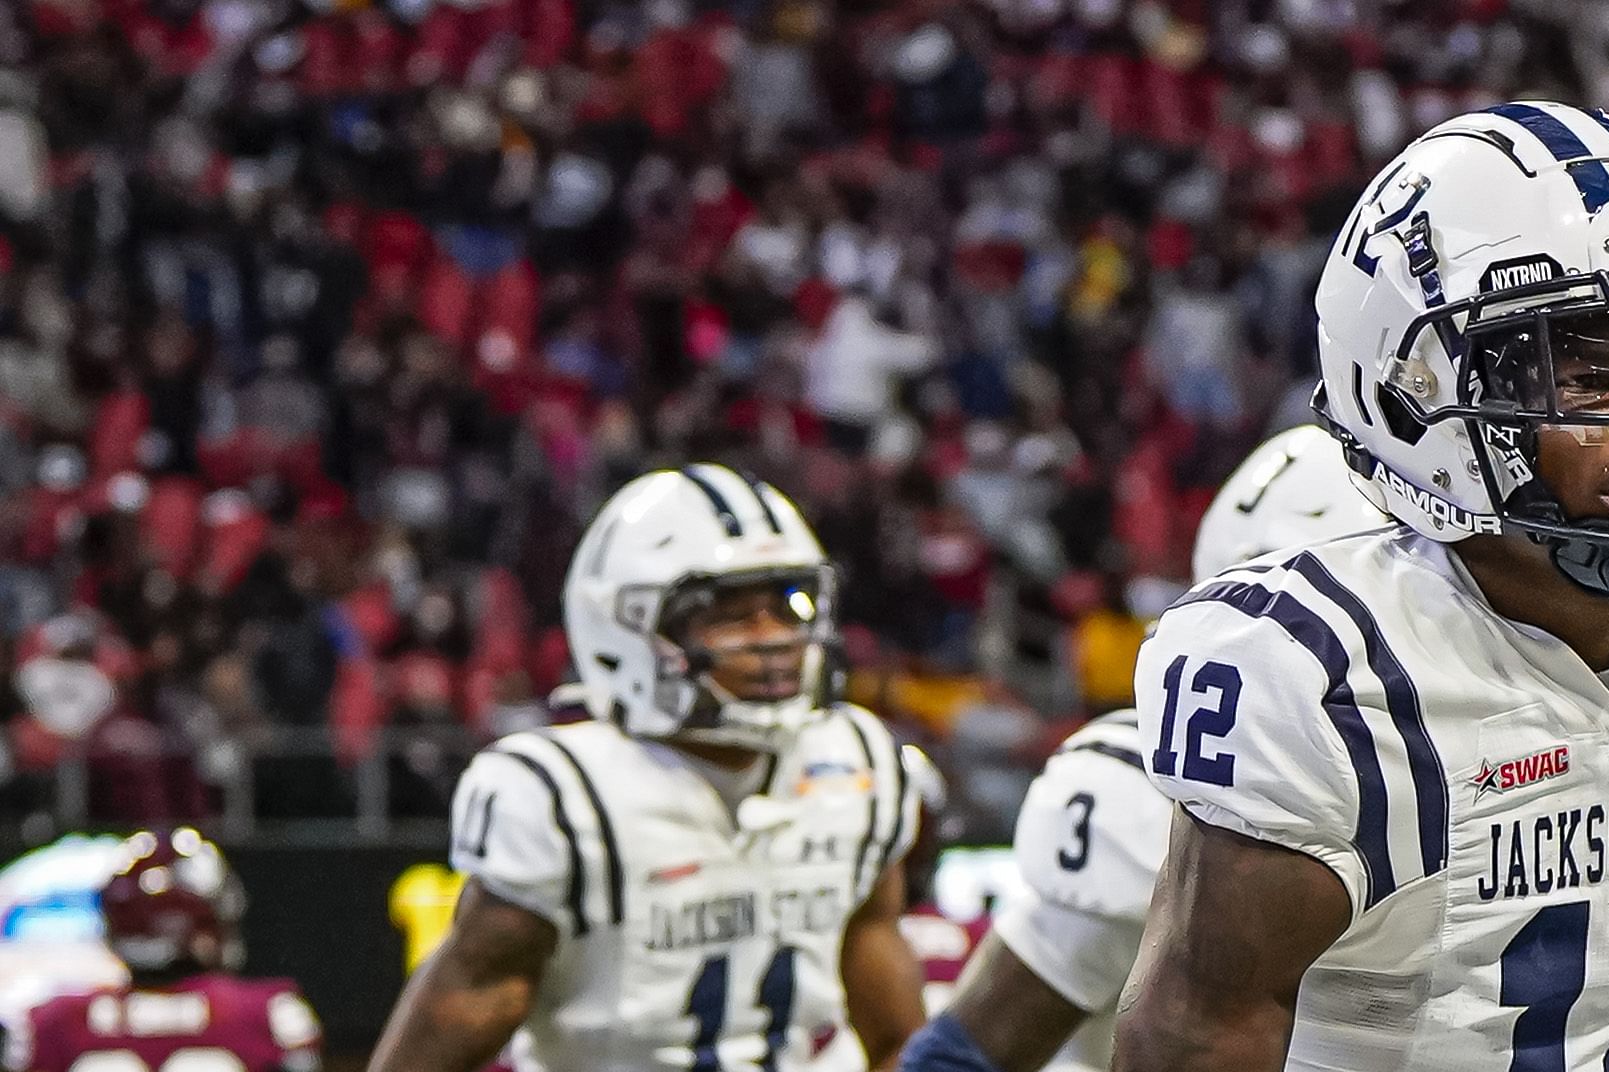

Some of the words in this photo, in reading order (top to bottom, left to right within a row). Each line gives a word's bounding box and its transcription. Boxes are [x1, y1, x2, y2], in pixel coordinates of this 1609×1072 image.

[1490, 262, 1553, 292] NXTRND
[1373, 461, 1503, 536] ARMOUR
[1152, 654, 1243, 787] 12
[1499, 747, 1569, 789] SWAC
[1058, 791, 1095, 872] 3
